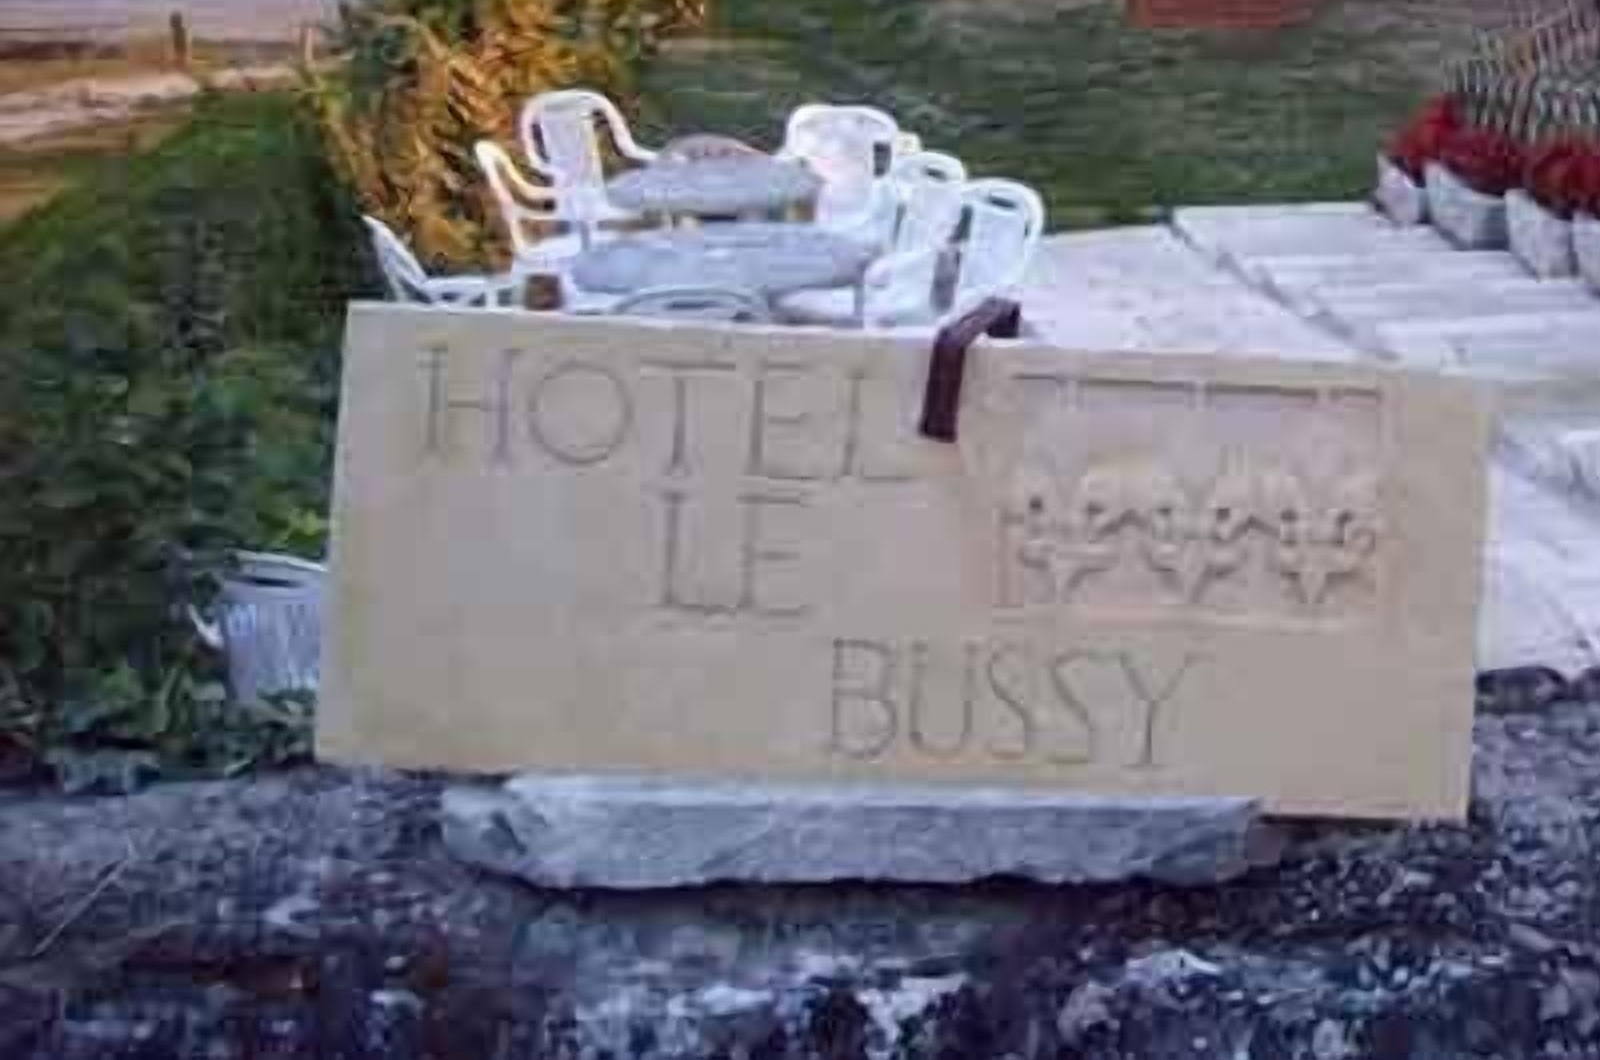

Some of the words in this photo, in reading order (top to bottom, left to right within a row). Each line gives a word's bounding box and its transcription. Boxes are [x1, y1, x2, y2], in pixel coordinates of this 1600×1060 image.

[415, 345, 918, 481] HOTEL
[648, 487, 812, 616] LE
[831, 637, 1210, 768] BUSSY
